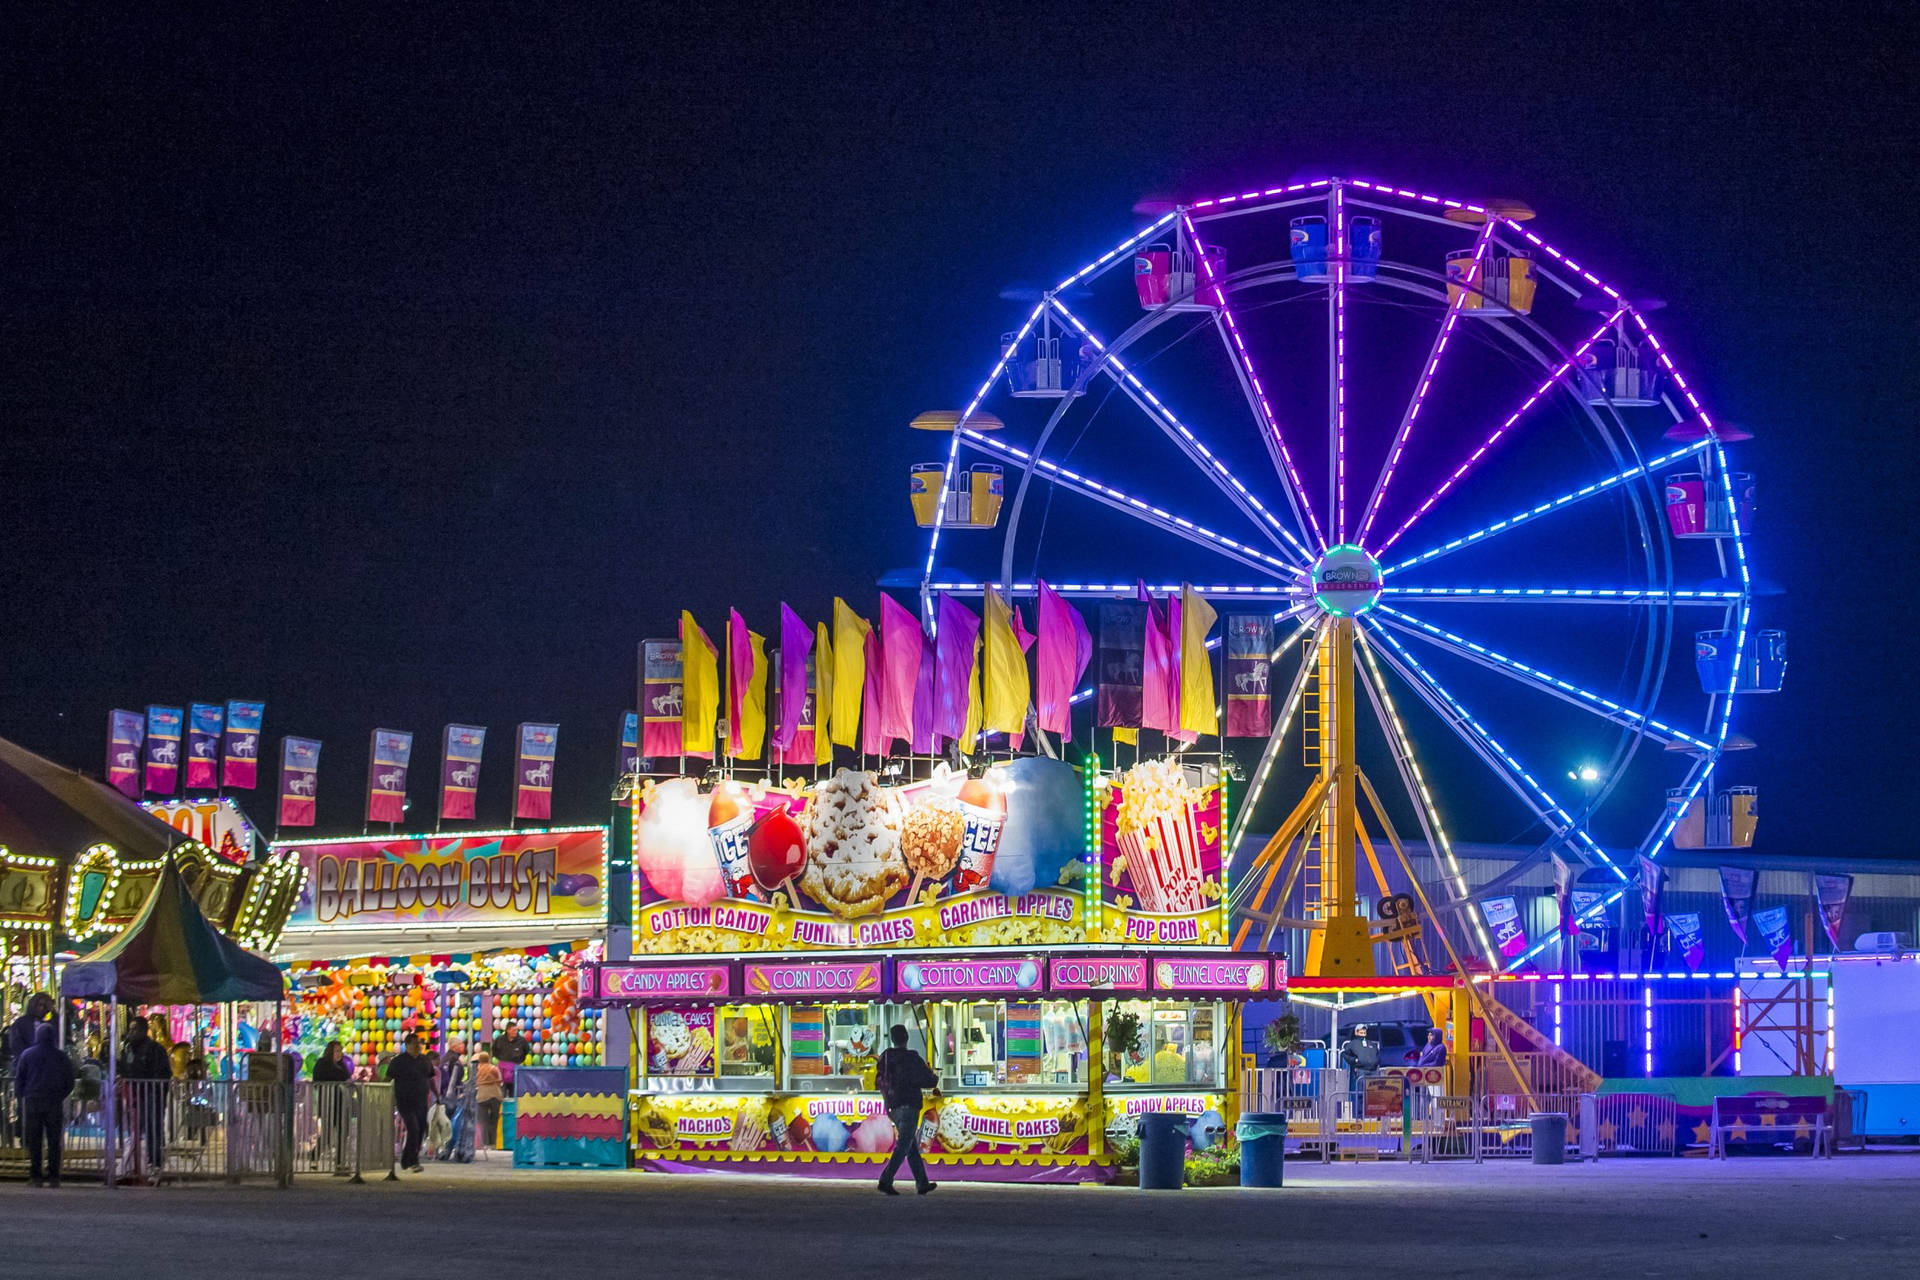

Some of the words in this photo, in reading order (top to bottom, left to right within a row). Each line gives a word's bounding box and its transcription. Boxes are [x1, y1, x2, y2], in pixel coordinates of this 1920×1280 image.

[152, 805, 218, 848] OT
[963, 812, 1001, 854] CEE
[713, 828, 748, 864] ICE
[317, 855, 464, 922] BALLOON
[468, 848, 558, 915] BUST
[650, 906, 712, 934] COTTON
[714, 906, 770, 936] CANDY
[940, 895, 1013, 930] CARAMEL
[1016, 893, 1074, 922] APPLES
[858, 916, 916, 945] CAKES
[1125, 916, 1156, 940] POP
[1157, 917, 1199, 941] CORN
[624, 973, 664, 991] CANDY
[666, 972, 705, 989] APPLES
[773, 970, 811, 988] CORN
[816, 969, 853, 987] DOGS
[919, 967, 974, 985] COTTON
[978, 966, 1020, 984] CANDY
[1056, 965, 1097, 984] COLD
[1099, 964, 1141, 984] DRINKS
[1172, 965, 1212, 985] FUNNEL
[1215, 965, 1249, 984] CAKES
[684, 1012, 711, 1026] CAKES
[809, 1099, 854, 1118] COTTON
[858, 1098, 888, 1116] CAN
[1126, 1097, 1163, 1115] CANDY
[1164, 1096, 1205, 1114] APPLES
[963, 1115, 1013, 1137] FUNNEL
[1015, 1117, 1061, 1138] CAKES
